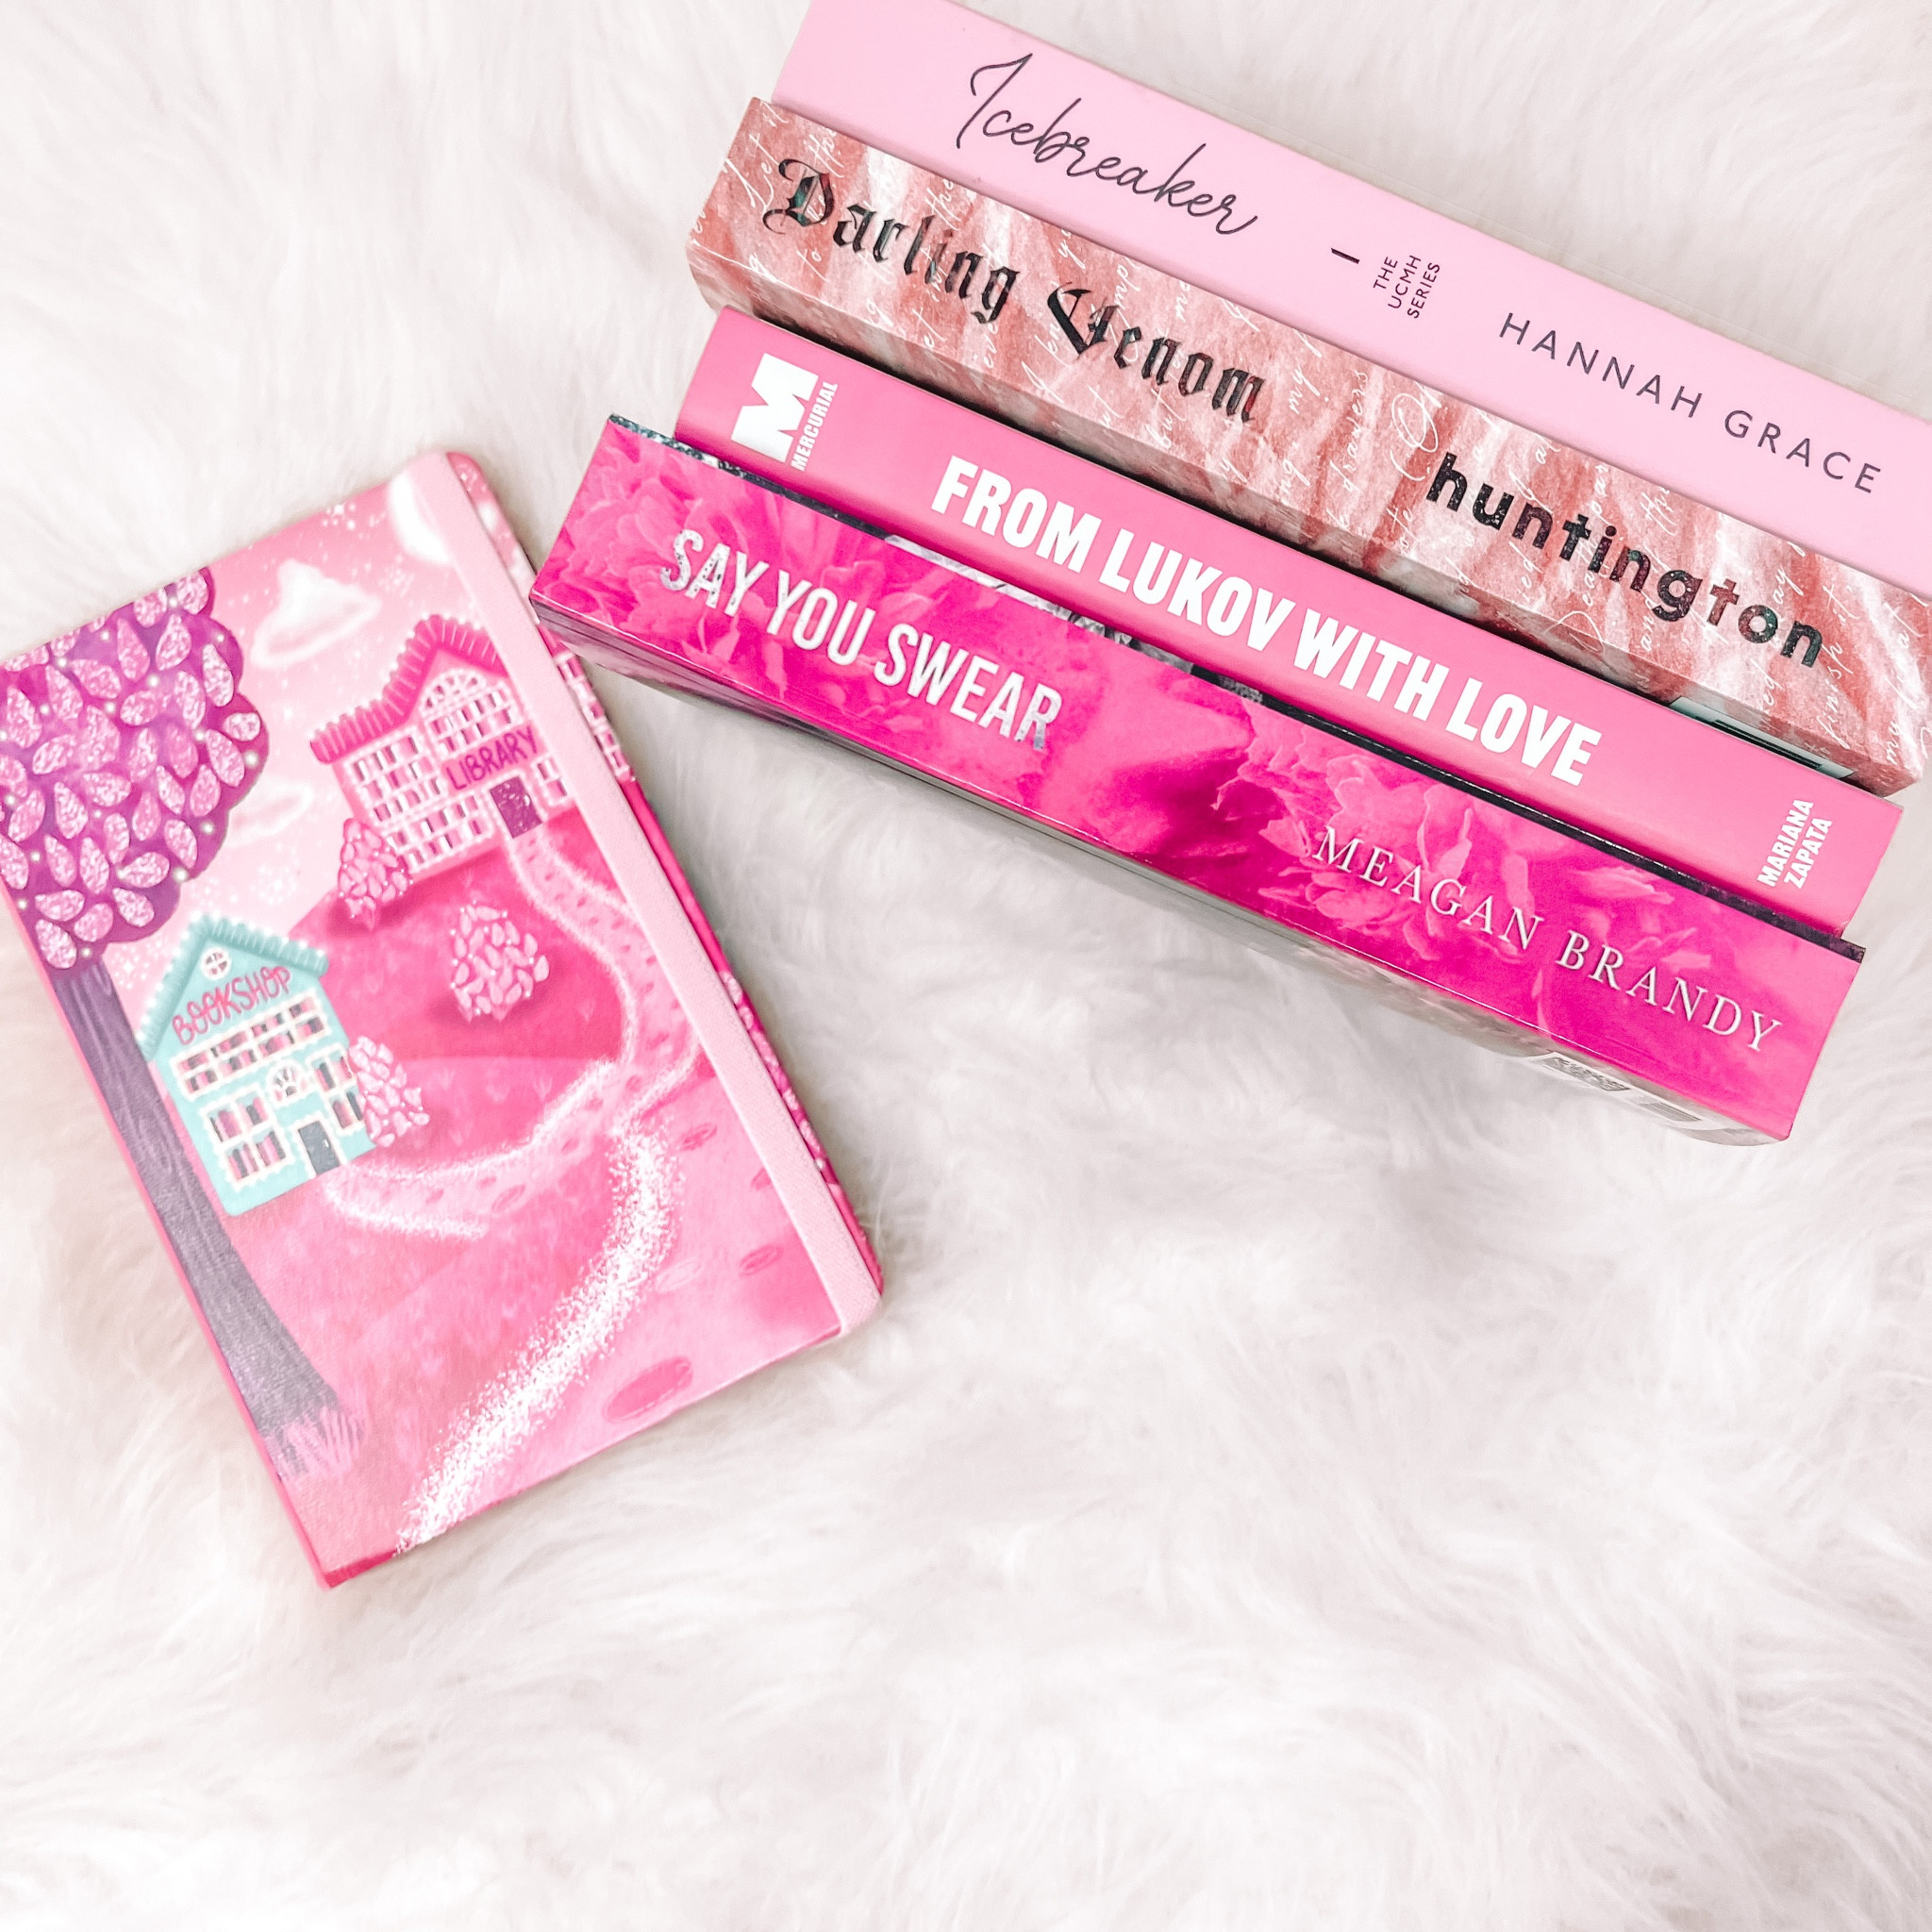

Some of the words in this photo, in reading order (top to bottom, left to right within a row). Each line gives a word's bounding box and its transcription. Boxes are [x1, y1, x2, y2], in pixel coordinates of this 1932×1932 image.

[957, 54, 1258, 236] Icebreaker
[762, 158, 1021, 325] Darling
[1046, 280, 1266, 424] Venom
[1373, 256, 1399, 290] THE
[1388, 255, 1422, 309] UCMH
[1407, 262, 1441, 319] SERIES
[791, 381, 839, 472] MERCURIAL
[1499, 312, 1703, 419] HANNAH
[1724, 409, 1882, 494] GRACE
[1425, 452, 1824, 669] huntington
[660, 528, 770, 617] SAY
[766, 569, 876, 666] YOU
[874, 623, 1063, 752] SWEAR
[932, 456, 1102, 574] FROM
[1098, 529, 1296, 652] LUKOV
[1293, 608, 1450, 722] WITH
[1445, 677, 1604, 787] LOVE
[447, 727, 540, 791] LIBRARY
[1757, 799, 1814, 888] MARIANA
[1783, 818, 1833, 890] ZAPATA
[1313, 825, 1542, 949] MEAGAN
[1556, 931, 1783, 1052] BRANDY
[171, 966, 292, 1047] BOOKSHOP
